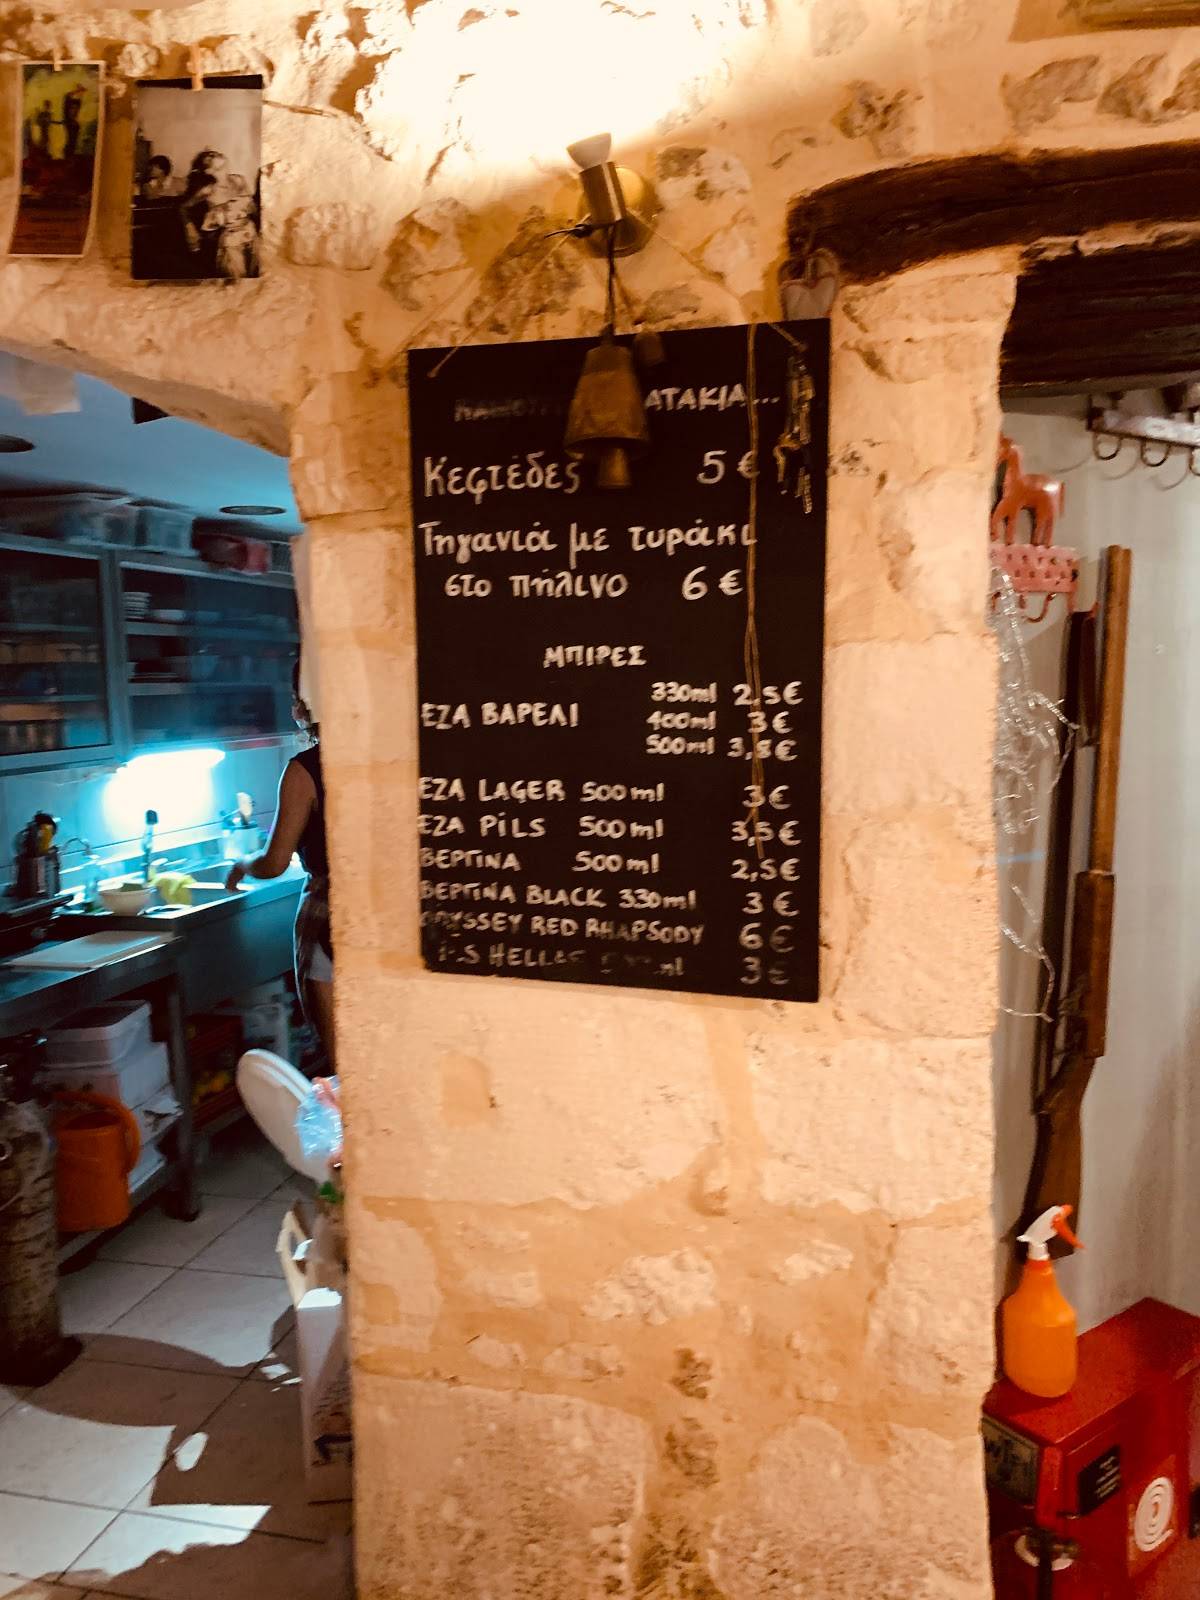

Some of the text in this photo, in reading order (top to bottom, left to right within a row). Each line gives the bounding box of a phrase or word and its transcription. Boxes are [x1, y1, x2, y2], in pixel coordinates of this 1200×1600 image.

[696, 450, 727, 484] 5
[736, 451, 759, 479] €
[418, 519, 758, 569] Τηγανιά με τυράκι
[444, 565, 744, 601] στο πήλινο 6 €
[542, 644, 648, 669] ΜΠΙΡΕΣ
[650, 681, 718, 704] 330ml
[481, 701, 581, 728] ΒΑΡΕΛΙ
[646, 710, 718, 731] 400ml
[645, 735, 716, 756] 500ml
[478, 777, 566, 805] LAGER
[525, 883, 608, 909] BLACK
[743, 891, 764, 916] 3
[772, 890, 800, 917] €
[421, 909, 796, 954] YSSEY RED RHAPSODY 6 €
[739, 955, 763, 986] 3
